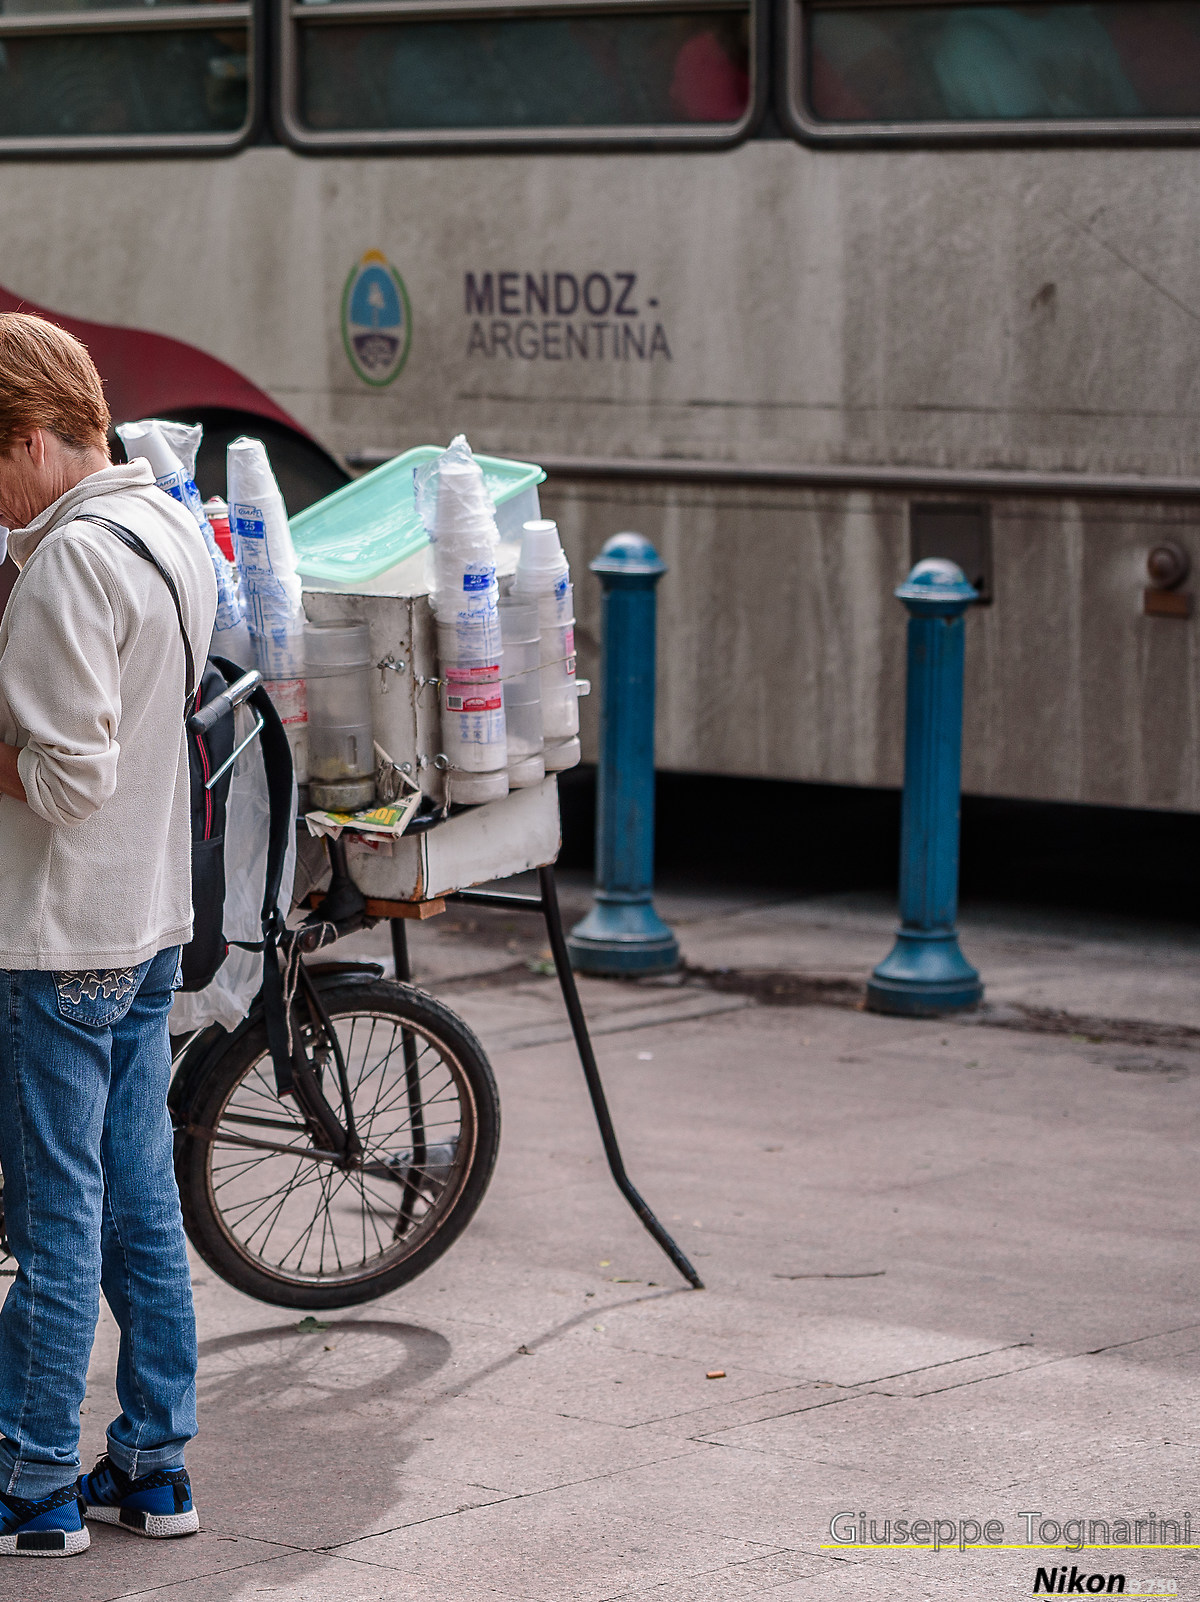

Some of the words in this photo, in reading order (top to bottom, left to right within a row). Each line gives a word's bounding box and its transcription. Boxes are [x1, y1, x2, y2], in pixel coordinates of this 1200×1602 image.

[464, 272, 659, 316] MENDOZ
[466, 320, 673, 362] ARGENTINA
[244, 521, 256, 531] 25
[470, 575, 482, 584] 25
